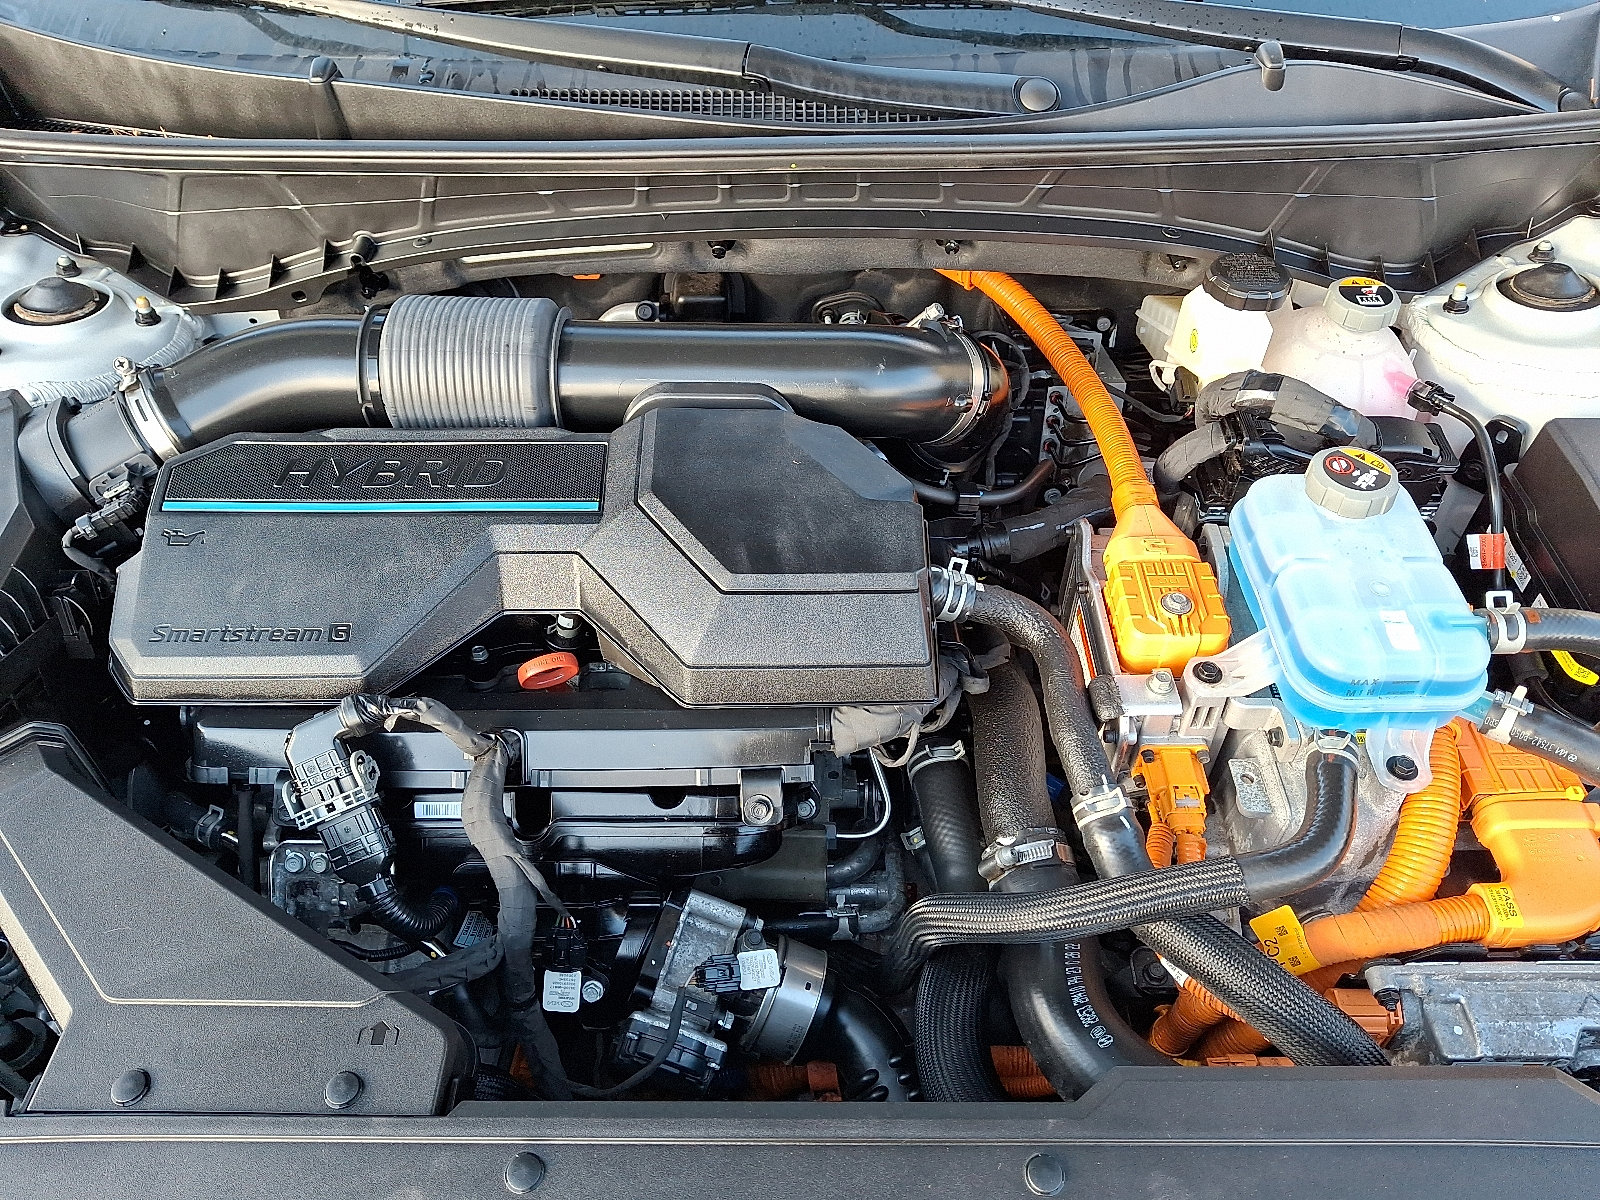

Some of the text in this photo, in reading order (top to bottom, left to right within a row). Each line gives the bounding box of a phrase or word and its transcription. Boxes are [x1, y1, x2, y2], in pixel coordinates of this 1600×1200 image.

[273, 457, 510, 487] HYBRID
[149, 623, 323, 643] Smartstream
[1349, 678, 1380, 686] MAX
[1346, 689, 1376, 697] MIN
[1499, 887, 1518, 917] PASS
